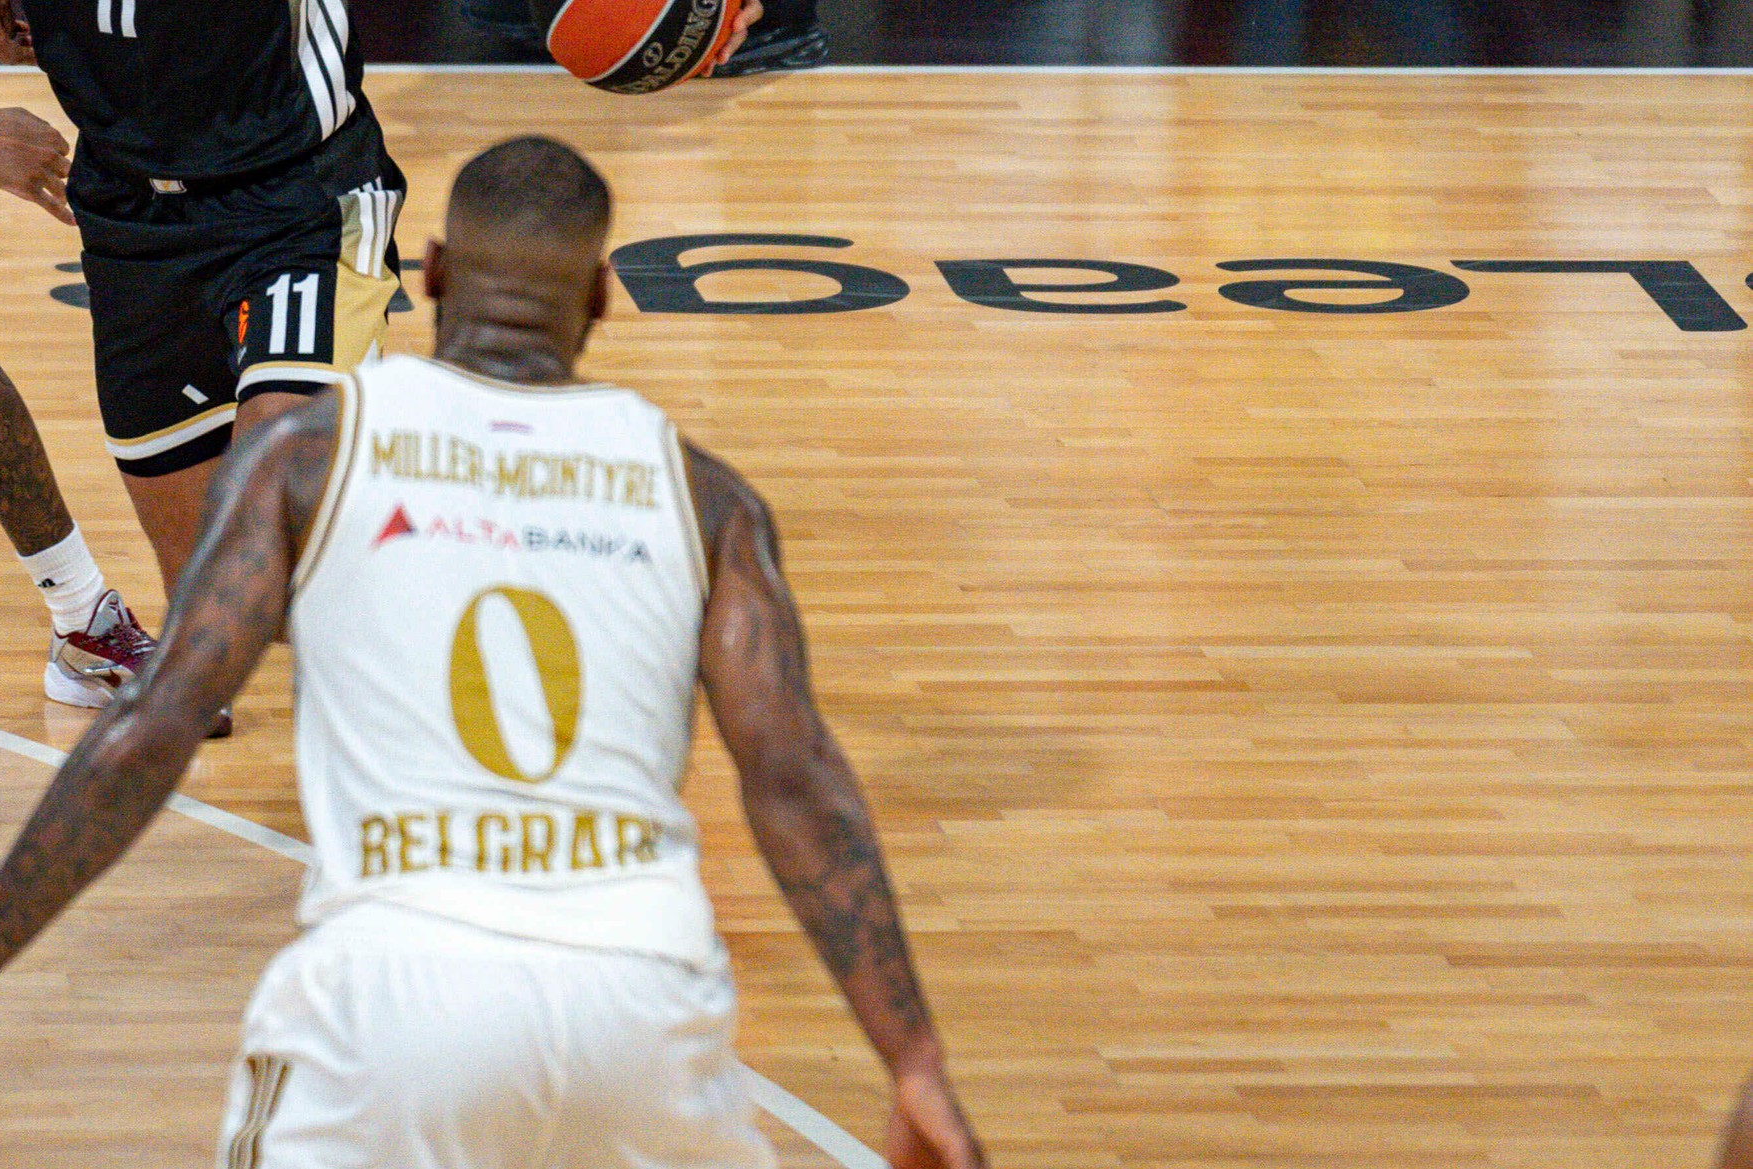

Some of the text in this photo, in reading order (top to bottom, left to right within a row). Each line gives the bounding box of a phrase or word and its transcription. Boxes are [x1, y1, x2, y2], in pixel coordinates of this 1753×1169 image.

[265, 273, 320, 355] 11
[369, 428, 661, 510] MILLER-MCINTYRE
[448, 585, 582, 785] 0
